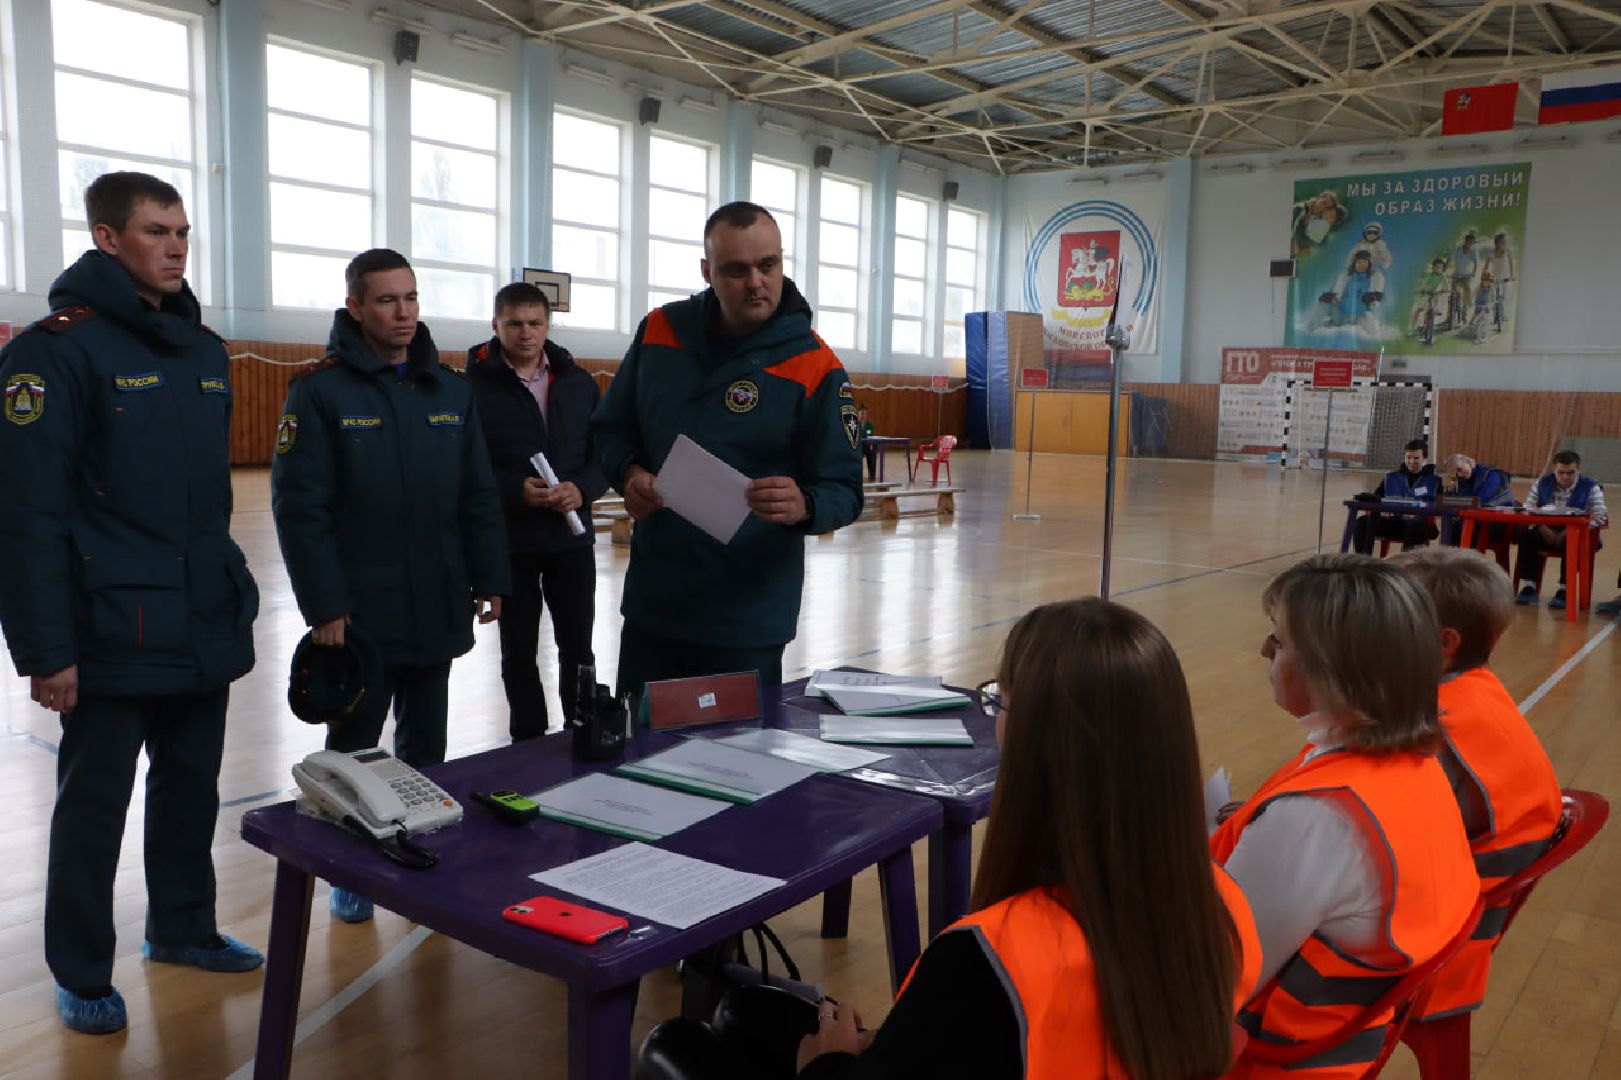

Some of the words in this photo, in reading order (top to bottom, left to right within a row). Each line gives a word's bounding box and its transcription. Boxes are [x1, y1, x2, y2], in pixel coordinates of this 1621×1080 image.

[1347, 182, 1376, 197] МЫ
[1384, 180, 1404, 195] ЗА
[1375, 199, 1434, 216] ОБРАЗ
[1442, 192, 1521, 212] ЖИЗНИ!
[1226, 351, 1259, 373] ГТО
